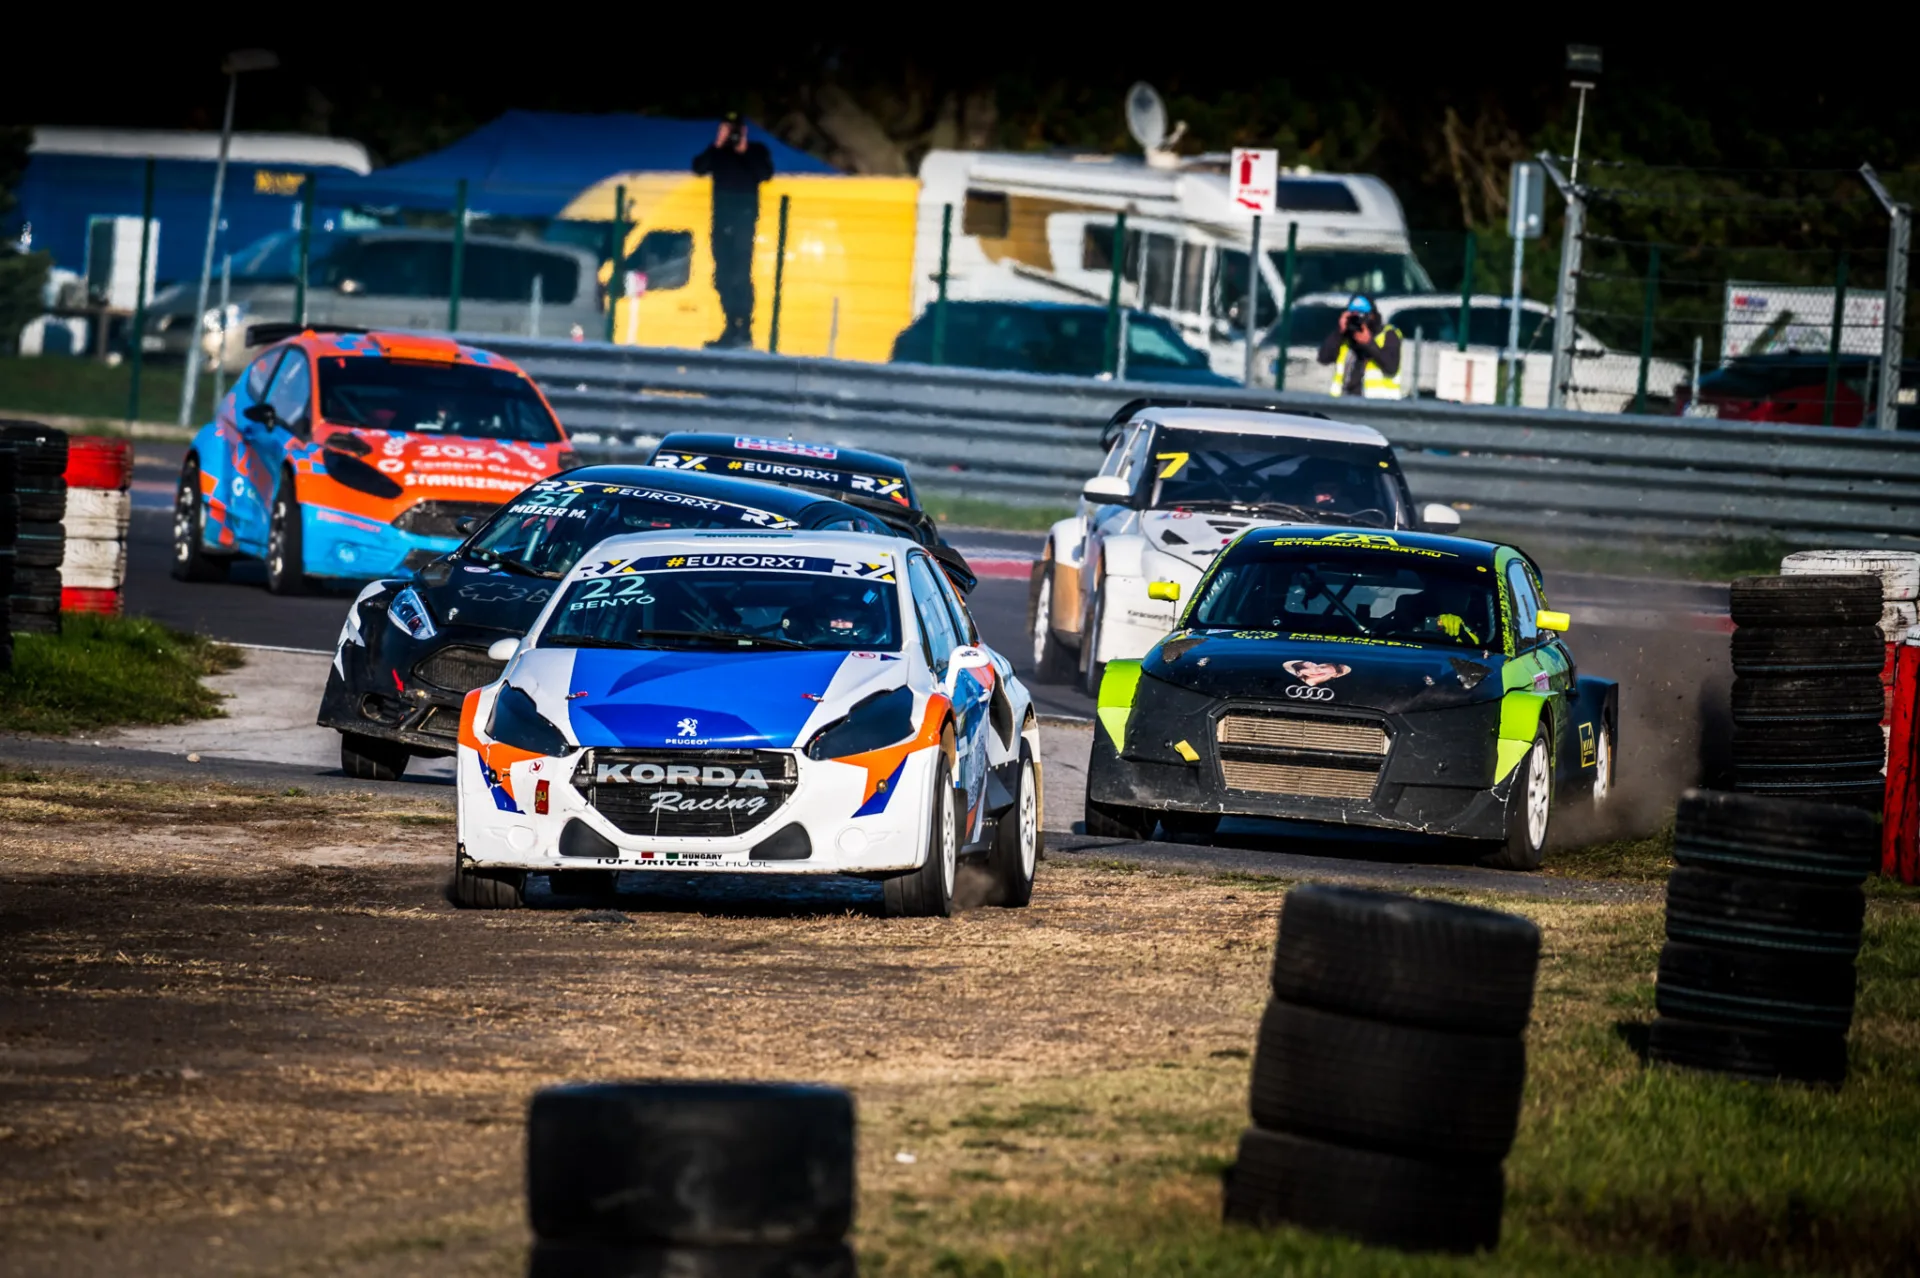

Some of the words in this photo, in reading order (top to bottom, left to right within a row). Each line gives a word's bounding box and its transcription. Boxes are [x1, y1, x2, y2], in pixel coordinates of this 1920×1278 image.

[420, 445, 509, 463] 2024
[1156, 452, 1189, 478] 7
[655, 455, 708, 471] RX
[727, 460, 839, 482] #EURORX1
[850, 474, 904, 499] RX
[528, 490, 580, 507] 51
[602, 486, 722, 511] #EURORX1
[568, 509, 587, 519] M.
[1273, 541, 1441, 558] EXTREMAUTOSPORT.HU
[665, 556, 806, 570] #EURORX1
[580, 576, 646, 600] 22
[570, 594, 656, 611] BENYÓ
[596, 763, 769, 790] KORDA
[649, 790, 768, 816] Racing
[682, 852, 723, 860] HUNGARY
